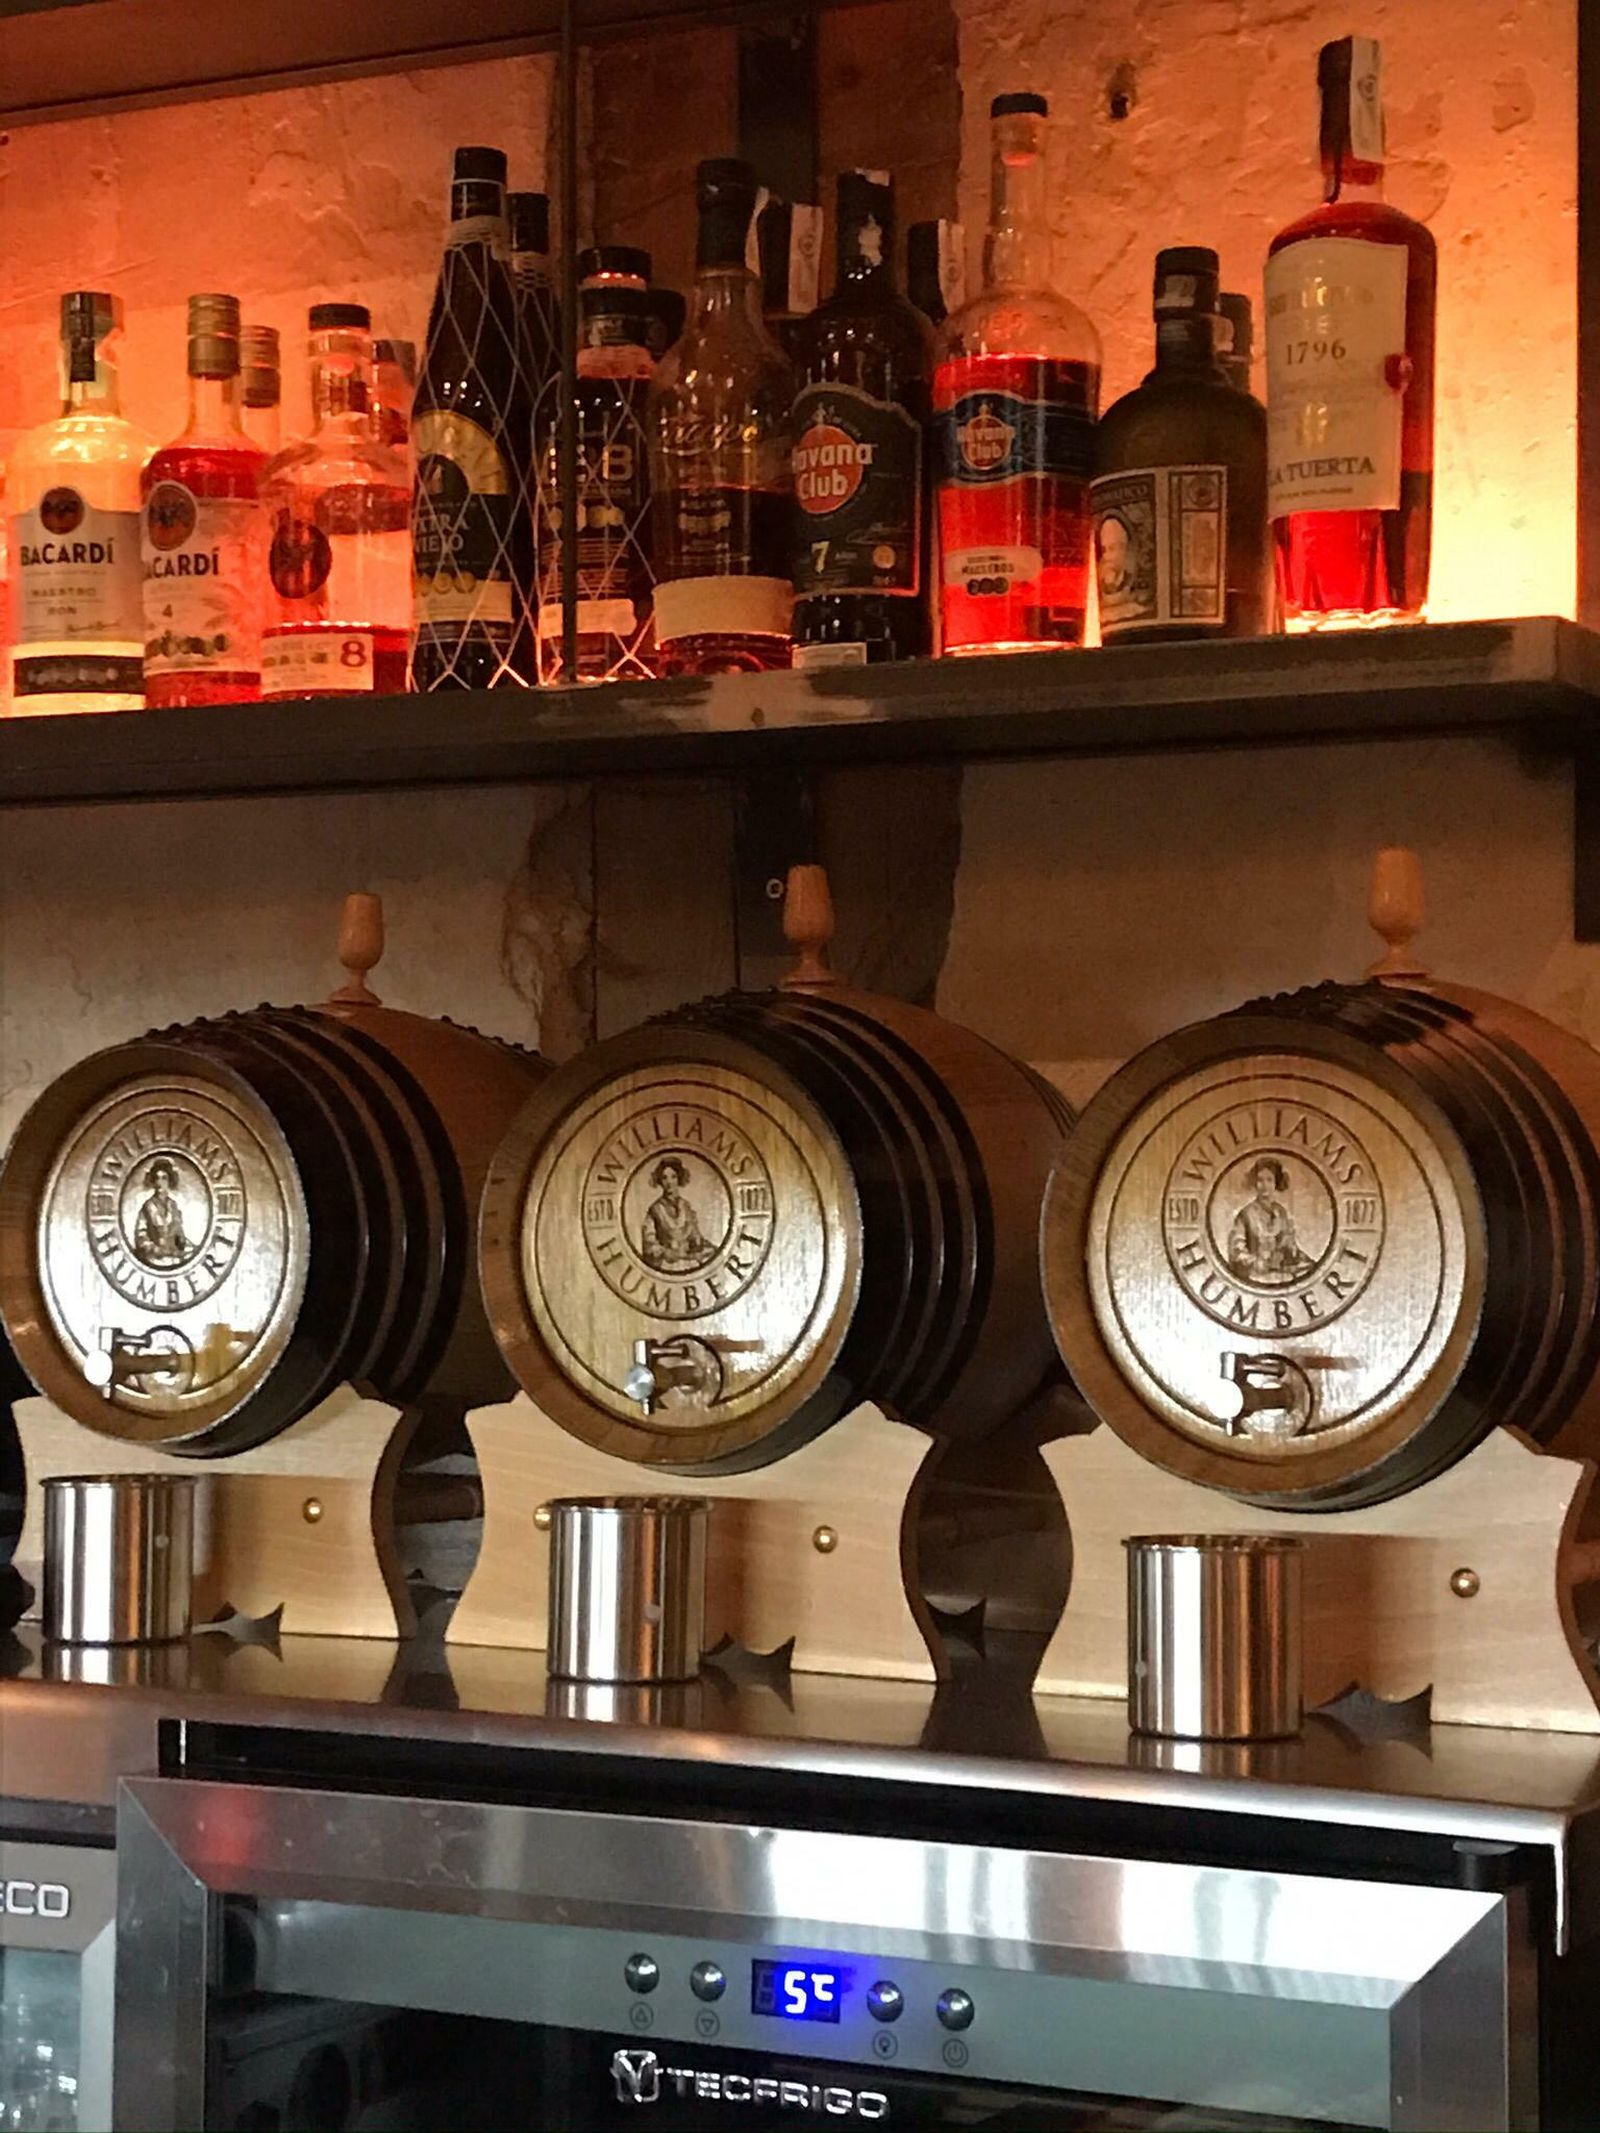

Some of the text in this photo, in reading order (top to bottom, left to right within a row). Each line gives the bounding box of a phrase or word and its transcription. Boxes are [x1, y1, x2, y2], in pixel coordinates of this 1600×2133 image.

[1286, 340, 1346, 365] 1796
[799, 469, 848, 500] Club
[1286, 456, 1376, 482] TUERTA
[20, 538, 115, 566] BACARDÍ
[811, 541, 830, 575] 7
[162, 604, 173, 618] 4
[340, 640, 367, 668] 8
[102, 1119, 230, 1181] WILLIAMS
[597, 1112, 754, 1184] WILLIAMS
[1183, 1110, 1363, 1184] WILLIAMS
[96, 1226, 235, 1305] HUMBERT
[597, 1225, 764, 1313] HUMBERT
[1176, 1239, 1368, 1329] HUMBERT
[0, 1880, 70, 1918] CO
